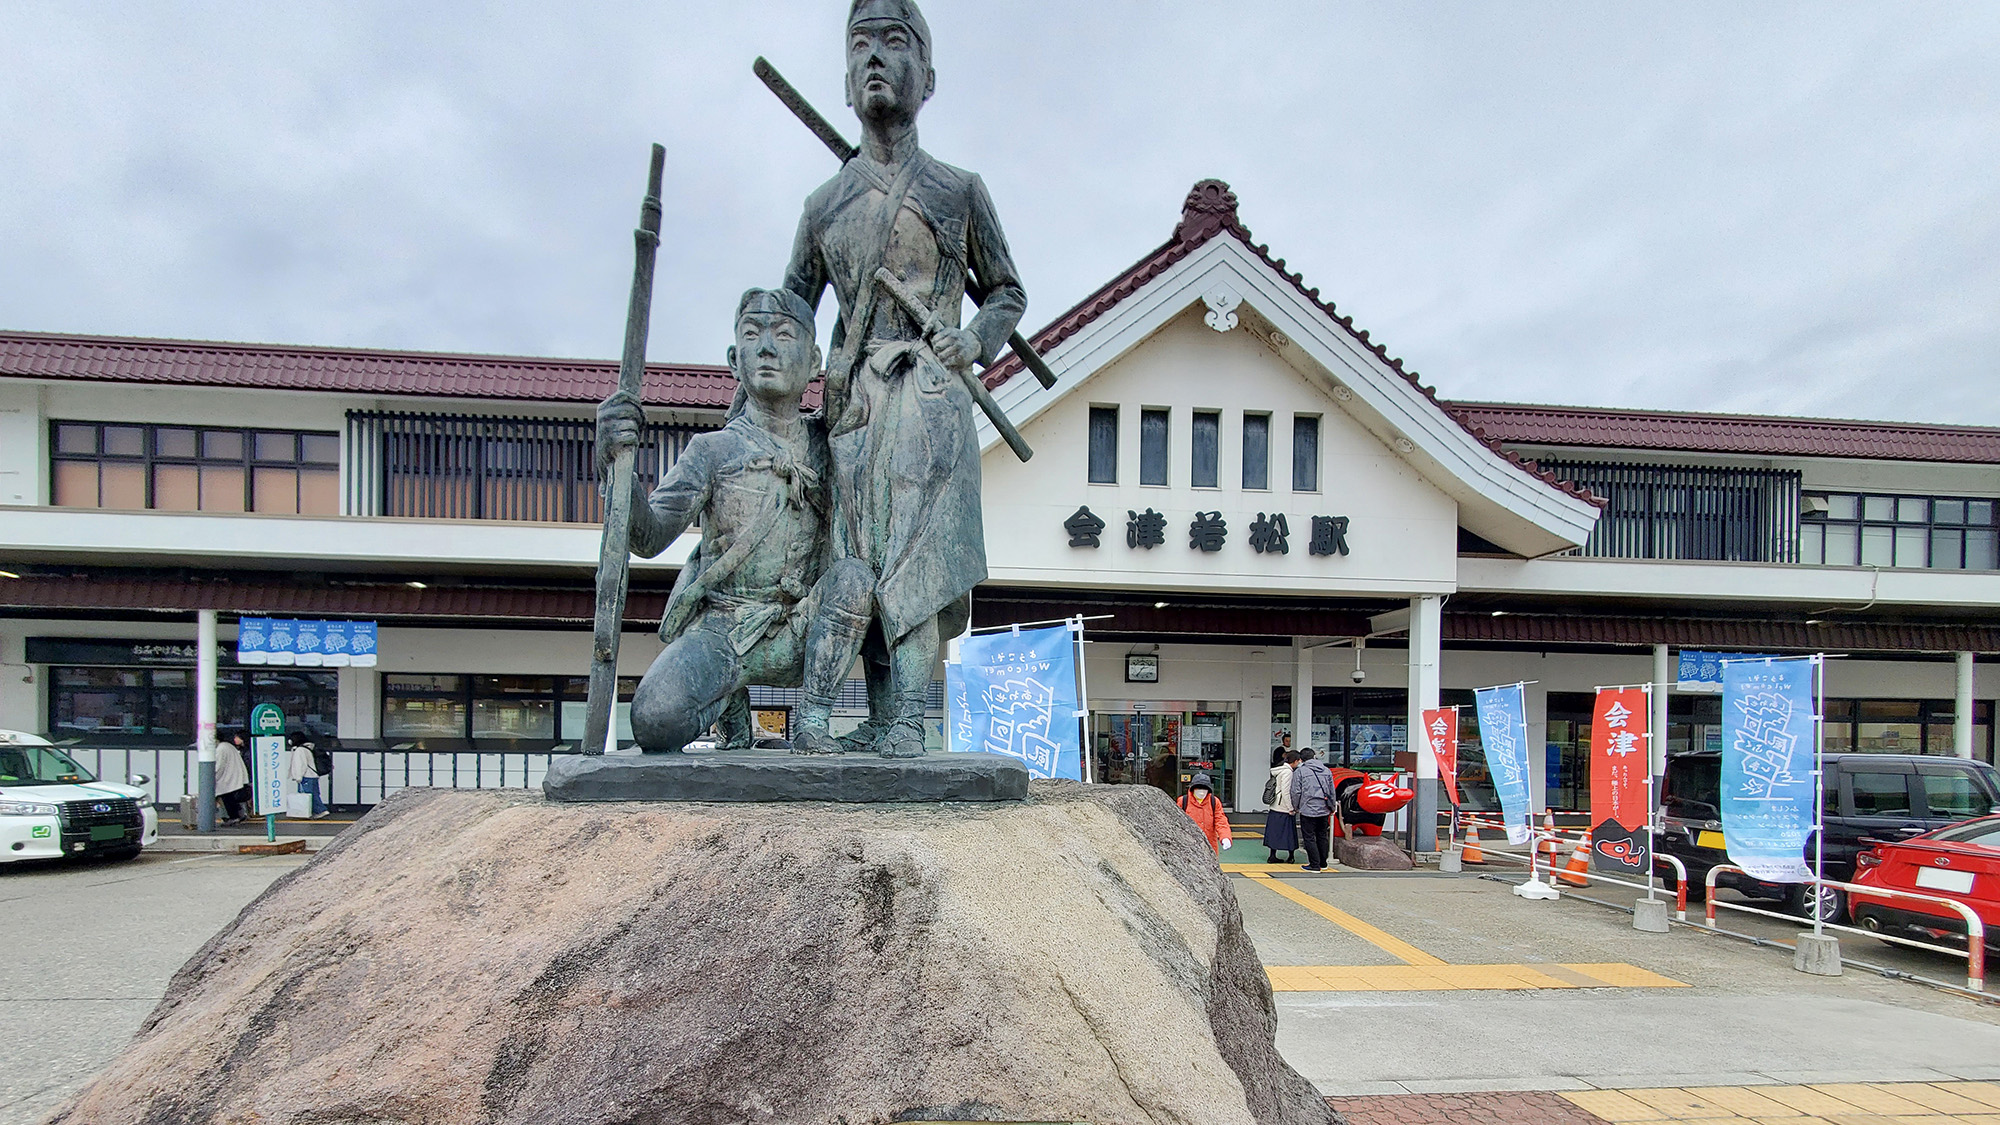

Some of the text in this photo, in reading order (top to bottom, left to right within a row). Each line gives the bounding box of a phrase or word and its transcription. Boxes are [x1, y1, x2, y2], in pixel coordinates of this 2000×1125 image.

[1063, 504, 1351, 557] 会津若松駅
[1604, 700, 1639, 758] 会津
[270, 741, 281, 808] タクシーのりば
